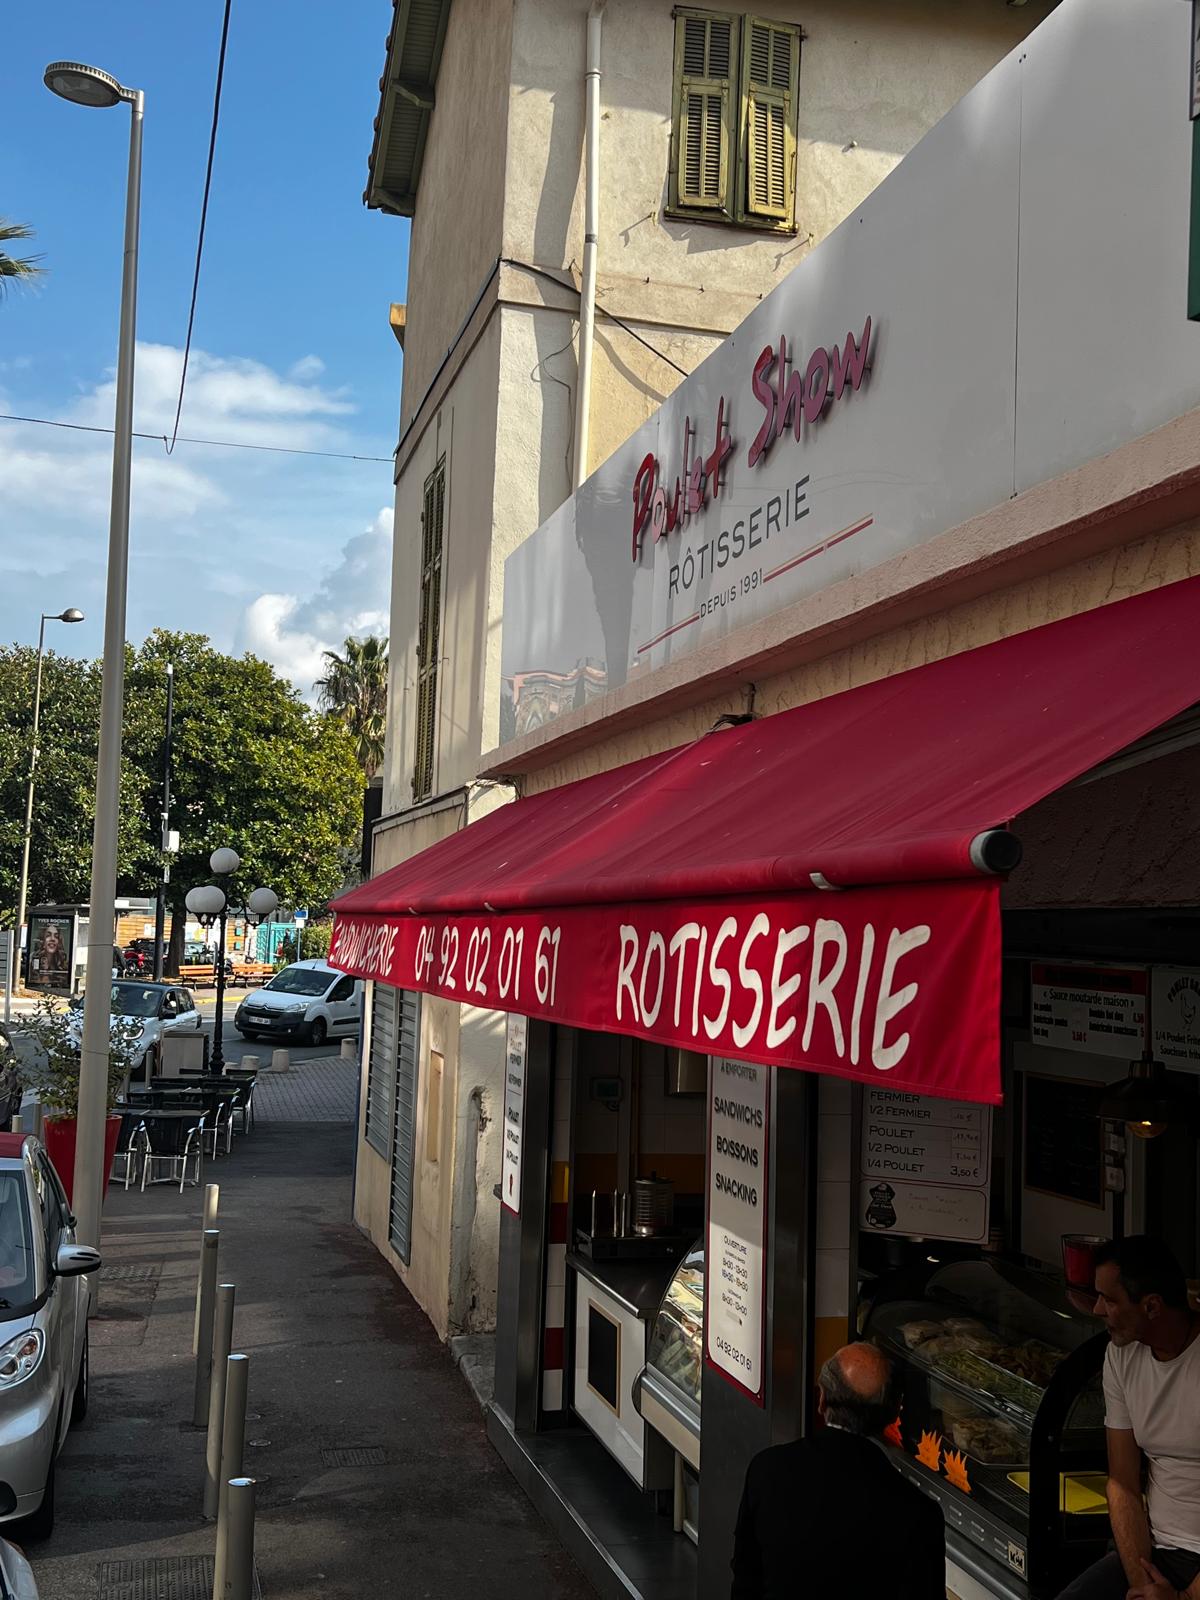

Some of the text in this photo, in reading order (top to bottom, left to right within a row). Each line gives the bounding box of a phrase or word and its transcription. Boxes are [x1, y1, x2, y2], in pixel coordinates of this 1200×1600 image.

[748, 315, 872, 467] Show
[668, 474, 811, 599] RÔTISSERIE
[700, 567, 764, 618] DEPUIS 1991
[414, 925, 436, 983] 04
[438, 925, 459, 990] 92
[465, 926, 491, 996] 02
[498, 926, 524, 1000] 01
[534, 925, 561, 1007] 61
[616, 912, 931, 1071] ROTISSERIE
[714, 1097, 763, 1128] SANDWICHS
[870, 1090, 920, 1104] FERMIER
[870, 1105, 883, 1115] 1/2
[885, 1106, 931, 1119] FERMIER
[869, 1125, 915, 1139] POULET
[716, 1135, 759, 1168] BOISSONS
[868, 1142, 882, 1153] 1/2
[884, 1144, 925, 1157] POULET
[867, 1158, 881, 1168] 1/4
[884, 1160, 925, 1173] POULET
[950, 1166, 971, 1178] 3,50
[715, 1172, 758, 1207] SNACKING
[716, 1336, 724, 1349] 04
[724, 1341, 731, 1356] 92
[732, 1347, 739, 1362] 02
[740, 1353, 746, 1368] 01
